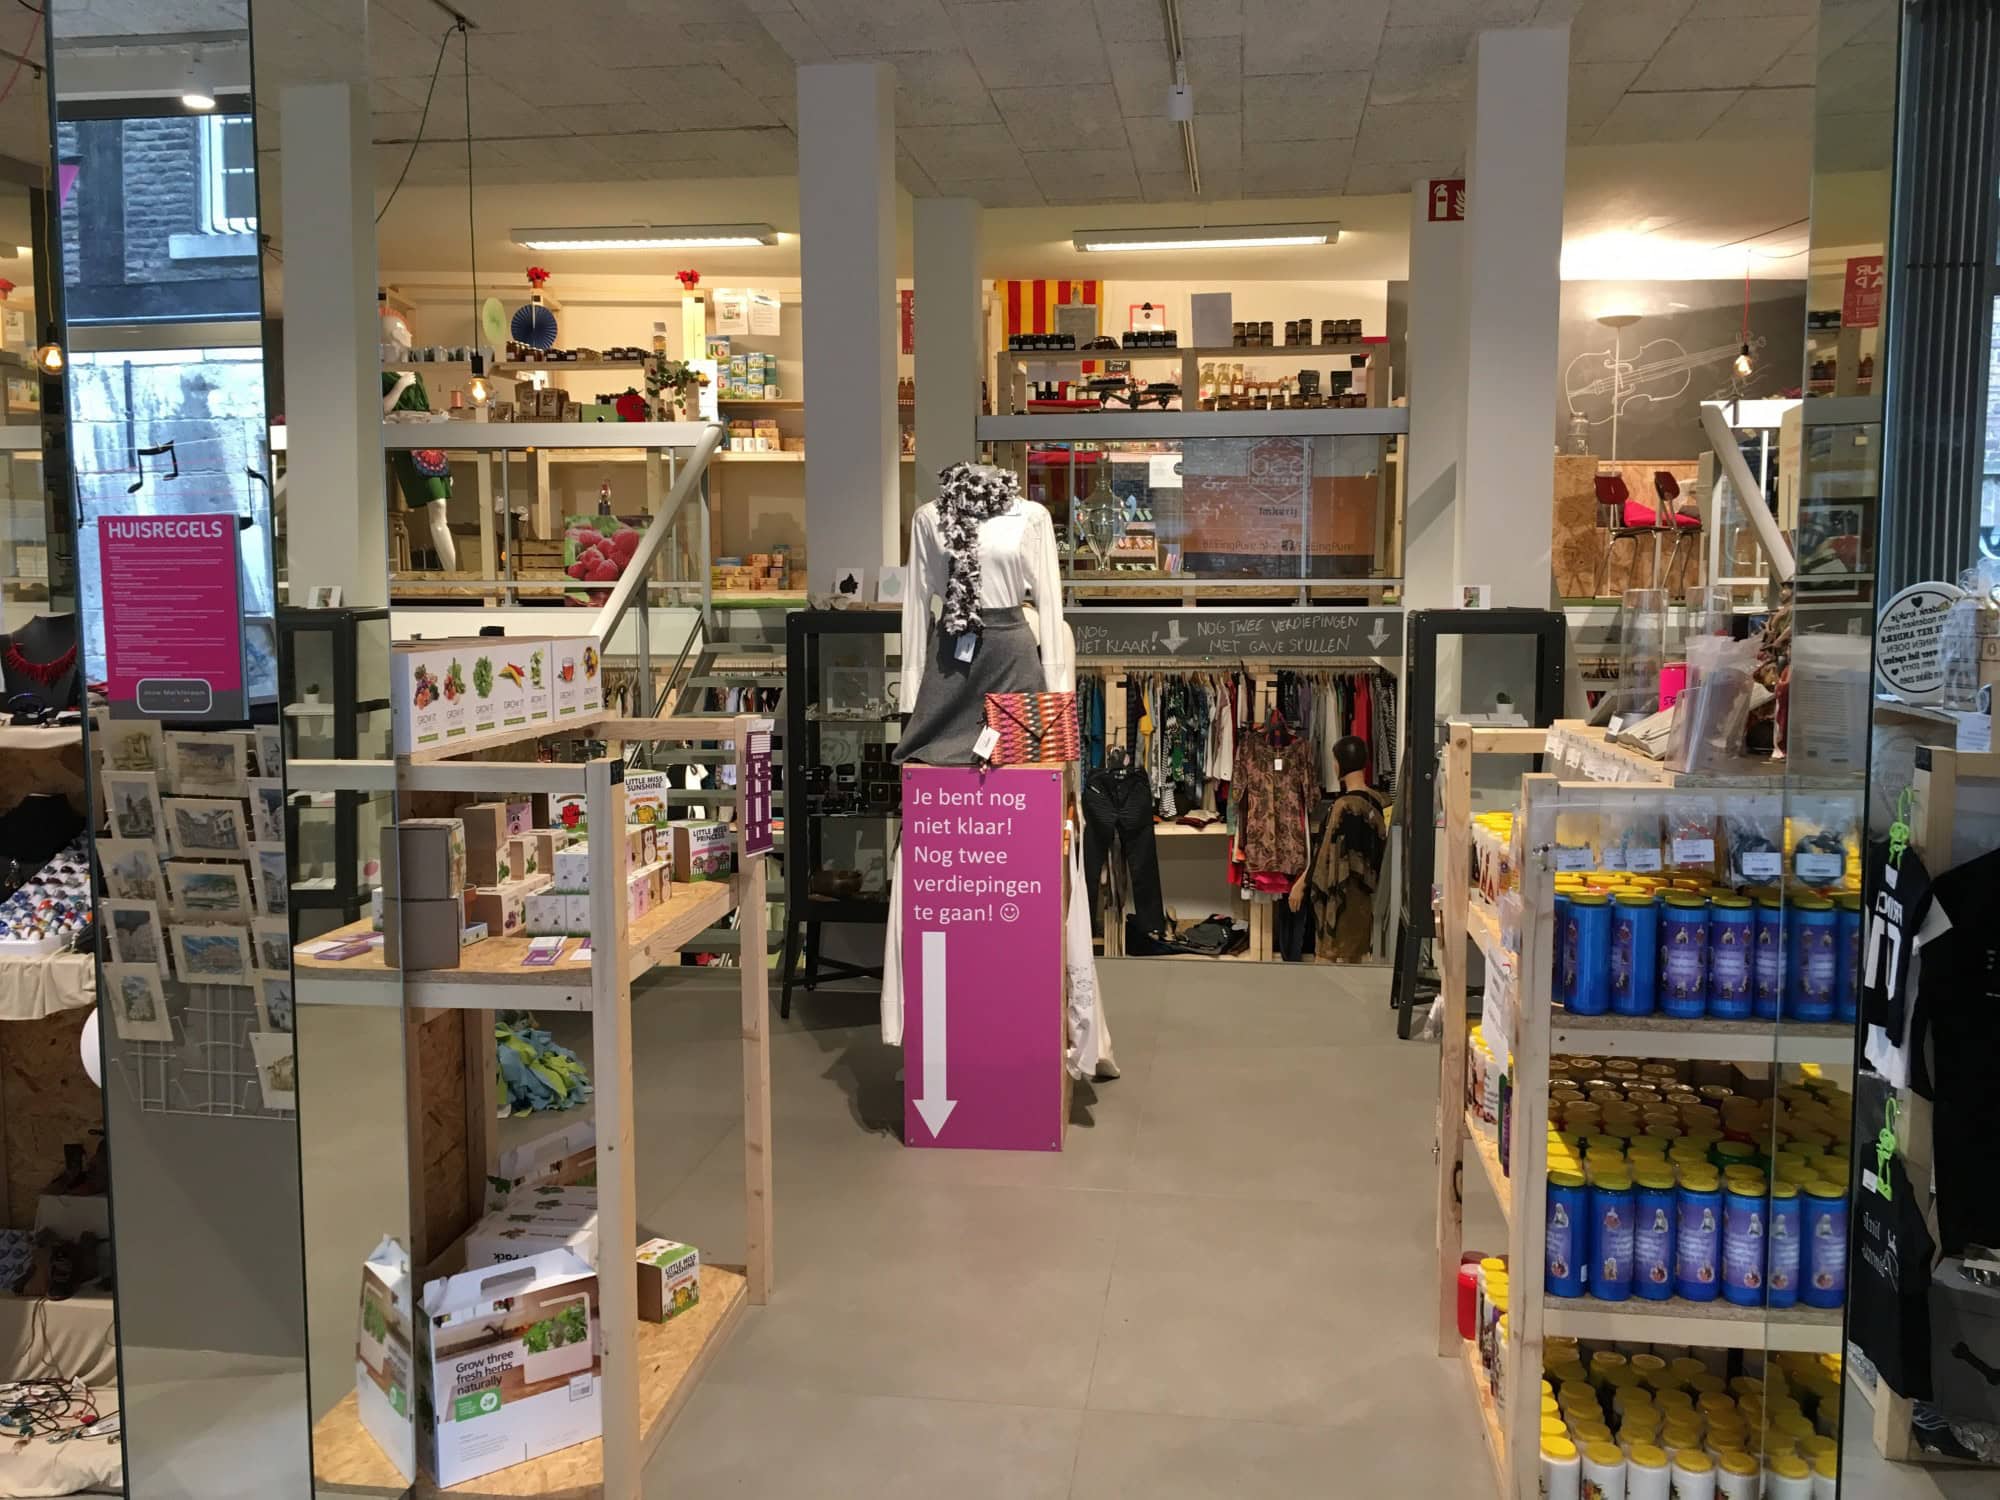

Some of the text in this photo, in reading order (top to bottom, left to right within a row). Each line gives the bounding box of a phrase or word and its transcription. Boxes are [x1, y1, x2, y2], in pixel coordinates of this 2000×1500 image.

[1259, 506, 1298, 518] Imkerij
[108, 521, 223, 539] HUISREGELS
[1076, 625, 1109, 639] NOG
[1197, 615, 1359, 636] NOG TWEE VERDIEPINGEN
[1209, 640, 1241, 653] MET
[625, 777, 645, 786] LITTLE
[627, 782, 663, 792] SUNSHINE
[913, 788, 1026, 811] Je bent nog
[693, 827, 712, 837] LITTLE
[913, 817, 1012, 835] niet klaar!
[914, 846, 1008, 867] Nog twee
[913, 875, 1041, 897] verdiepingen
[913, 904, 993, 925] te gaan!
[455, 1350, 514, 1373] Grow three
[457, 1361, 513, 1385] fresh herbs
[457, 1375, 502, 1396] naturally
